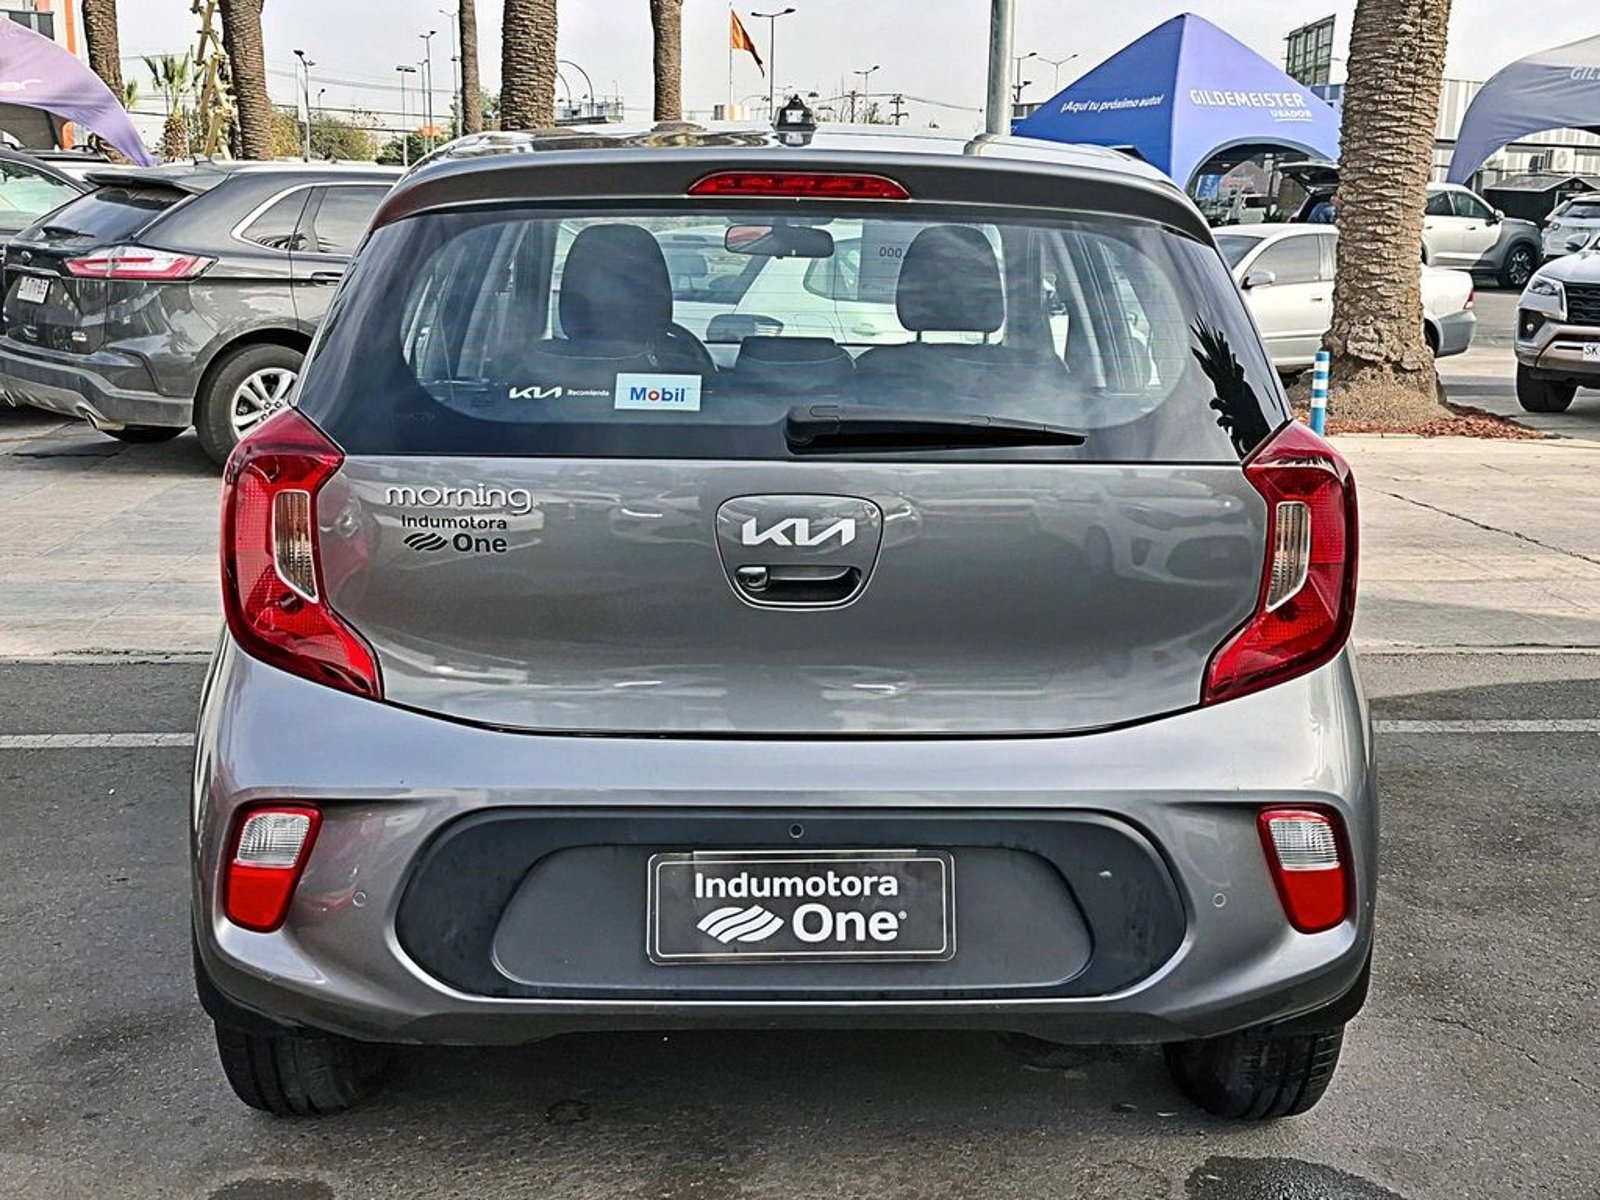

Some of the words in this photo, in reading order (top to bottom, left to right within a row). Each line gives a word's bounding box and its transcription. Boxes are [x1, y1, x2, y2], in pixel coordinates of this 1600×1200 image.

[1571, 67, 1600, 80] GIL
[1190, 89, 1306, 107] GILDEMEISTER
[509, 386, 562, 399] KIA
[567, 389, 610, 397] Recomienda
[630, 386, 685, 402] Mobil
[386, 482, 533, 515] morning
[402, 514, 507, 529] Indumotora
[742, 516, 856, 546] KIA
[453, 533, 507, 553] One
[695, 871, 898, 898] Indumotora
